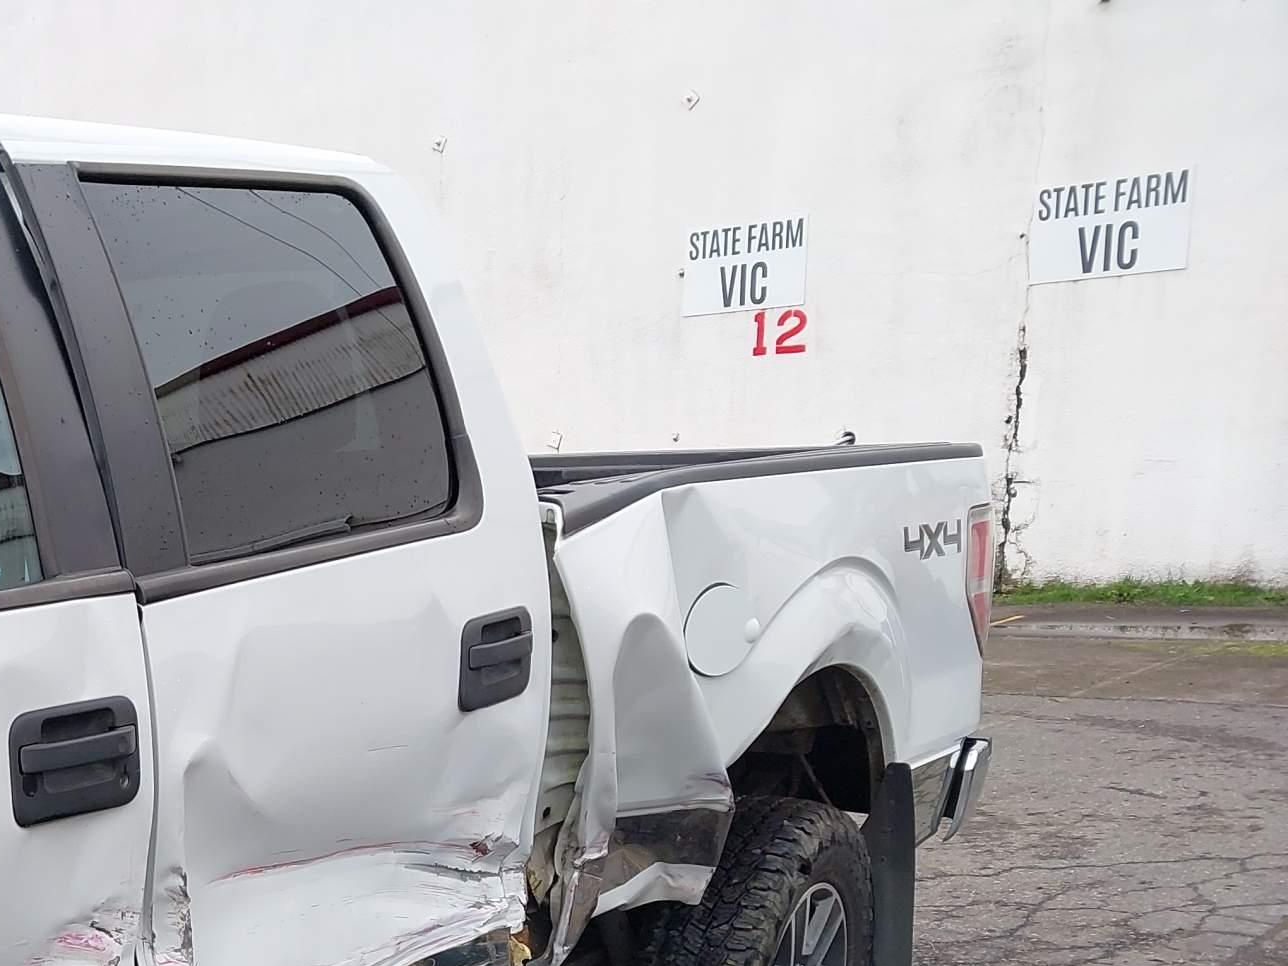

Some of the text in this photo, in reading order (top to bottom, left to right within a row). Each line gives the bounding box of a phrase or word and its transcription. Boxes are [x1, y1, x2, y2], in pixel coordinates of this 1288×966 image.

[1038, 168, 1189, 222] STATE FARM
[689, 217, 805, 261] STATE FARM
[1078, 220, 1139, 274] VIC
[720, 261, 768, 308] VIC
[752, 309, 808, 357] 12
